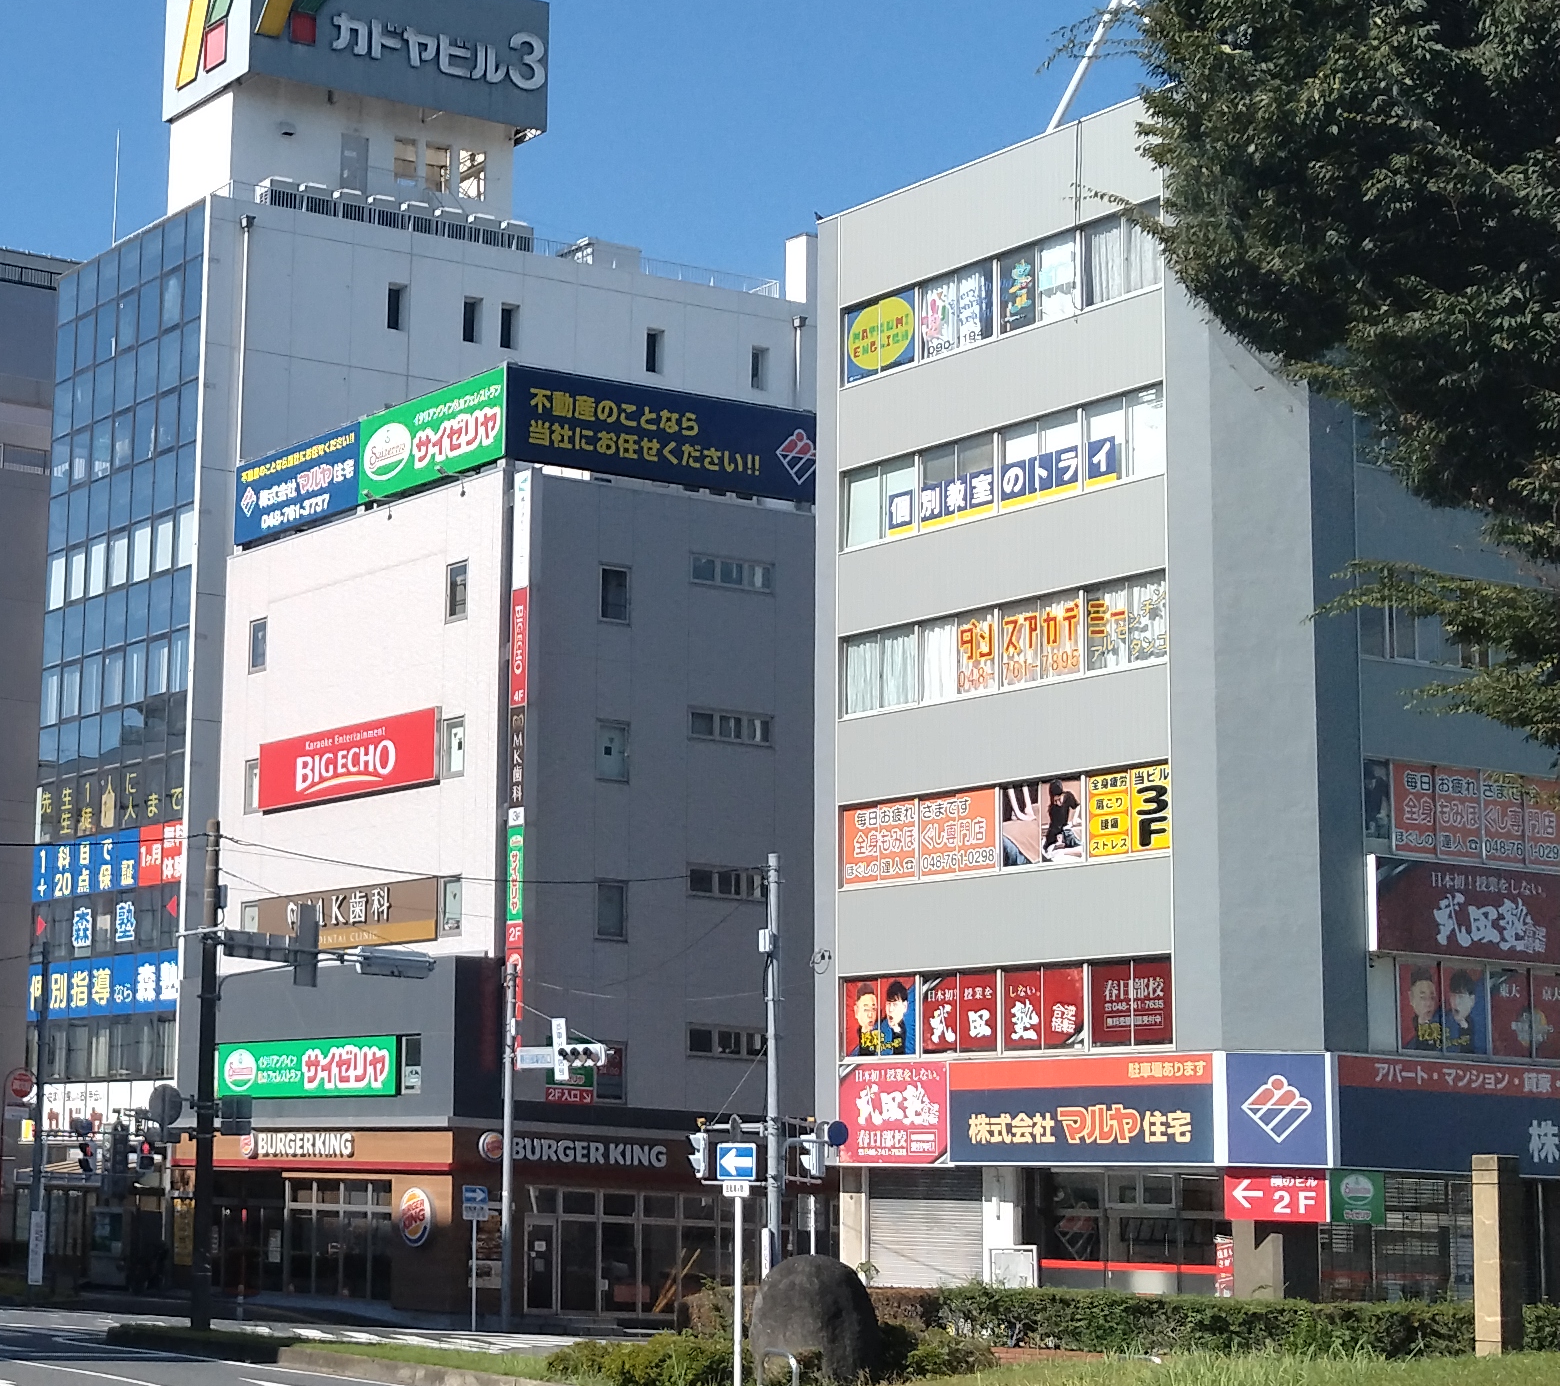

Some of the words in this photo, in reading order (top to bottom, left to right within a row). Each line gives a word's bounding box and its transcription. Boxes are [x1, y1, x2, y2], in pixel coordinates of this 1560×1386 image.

[331, 12, 546, 91] カドヤビル3
[528, 387, 700, 439] 不動産のことなら
[412, 405, 502, 469] サイゼリヤ
[958, 598, 1127, 663] ダンスアカデミー
[305, 737, 333, 751] Karaoke
[334, 725, 386, 745] Entertainment
[295, 752, 334, 793] BIG
[336, 739, 397, 776] ECHO
[1134, 767, 1170, 786] 当ビル
[855, 796, 970, 828] 毎日お疲れさまです
[1095, 797, 1123, 811] 肩こり
[1403, 794, 1556, 838] 全身もみほぐし専門店
[854, 817, 987, 857] 全身もみほぐし専門店
[1092, 837, 1128, 852] ストレス
[922, 848, 995, 871] 048-761-0298
[308, 885, 391, 926] K歯科
[1103, 976, 1165, 1001] 春日部校
[1499, 983, 1522, 999] 東大
[302, 1045, 391, 1090] サイゼリヤ
[1127, 1060, 1207, 1079] 駐車場あります
[547, 1087, 581, 1102] 2F入口
[856, 1129, 908, 1148] 春日部校
[968, 1104, 1193, 1145] 株式会社マルヤ住宅
[257, 1133, 314, 1156] BURGER
[314, 1132, 354, 1157] KING
[511, 1135, 605, 1165] BURGER
[610, 1142, 668, 1169] KING
[1528, 1119, 1560, 1164] 株
[1272, 1190, 1317, 1215] 2F
